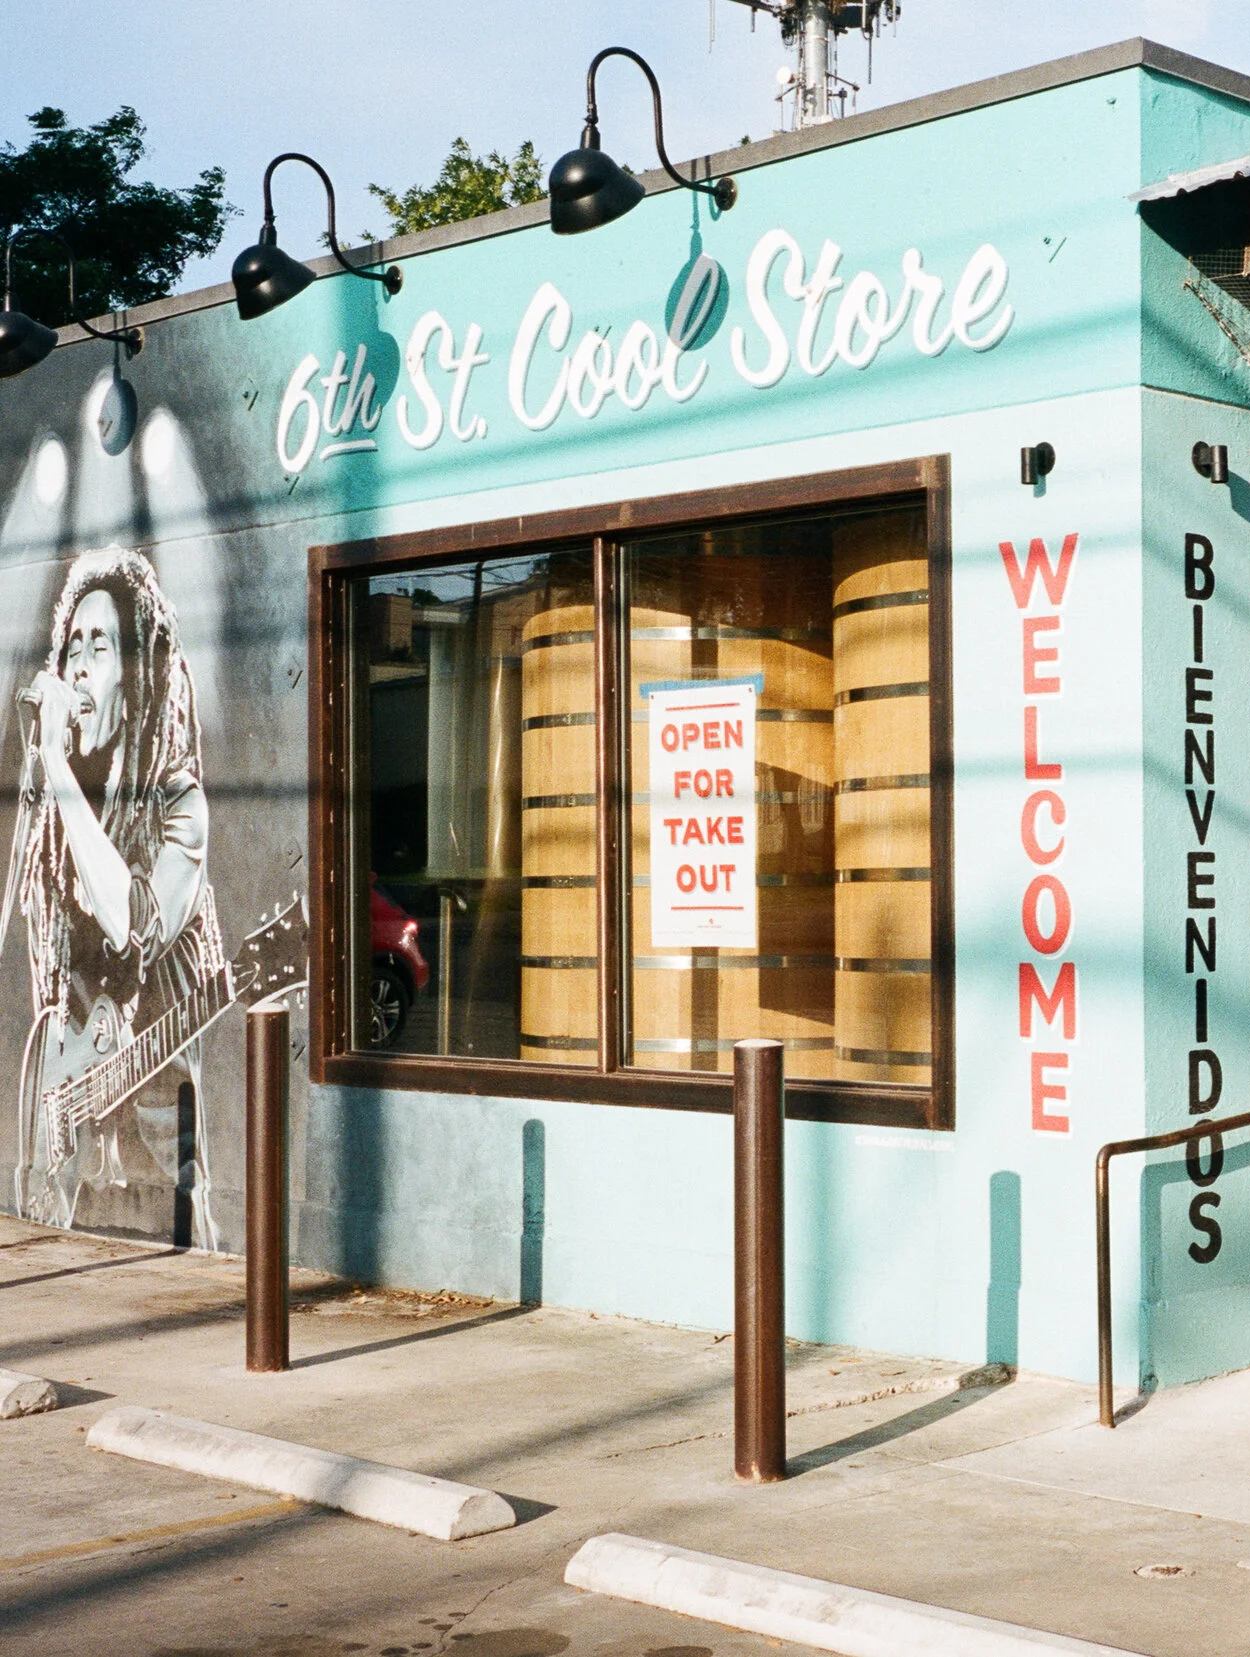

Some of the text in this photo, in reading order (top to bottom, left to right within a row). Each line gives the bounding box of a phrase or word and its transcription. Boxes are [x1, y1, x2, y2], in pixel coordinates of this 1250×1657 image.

[277, 228, 1015, 473] 6th St. Cool Store
[660, 719, 744, 753] OPEN
[673, 768, 735, 799] FOR
[663, 816, 745, 846] TAKE
[997, 531, 1081, 1136] WELCOME
[675, 863, 736, 894] OUT
[1184, 532, 1224, 1264] BIENVENIDOS
